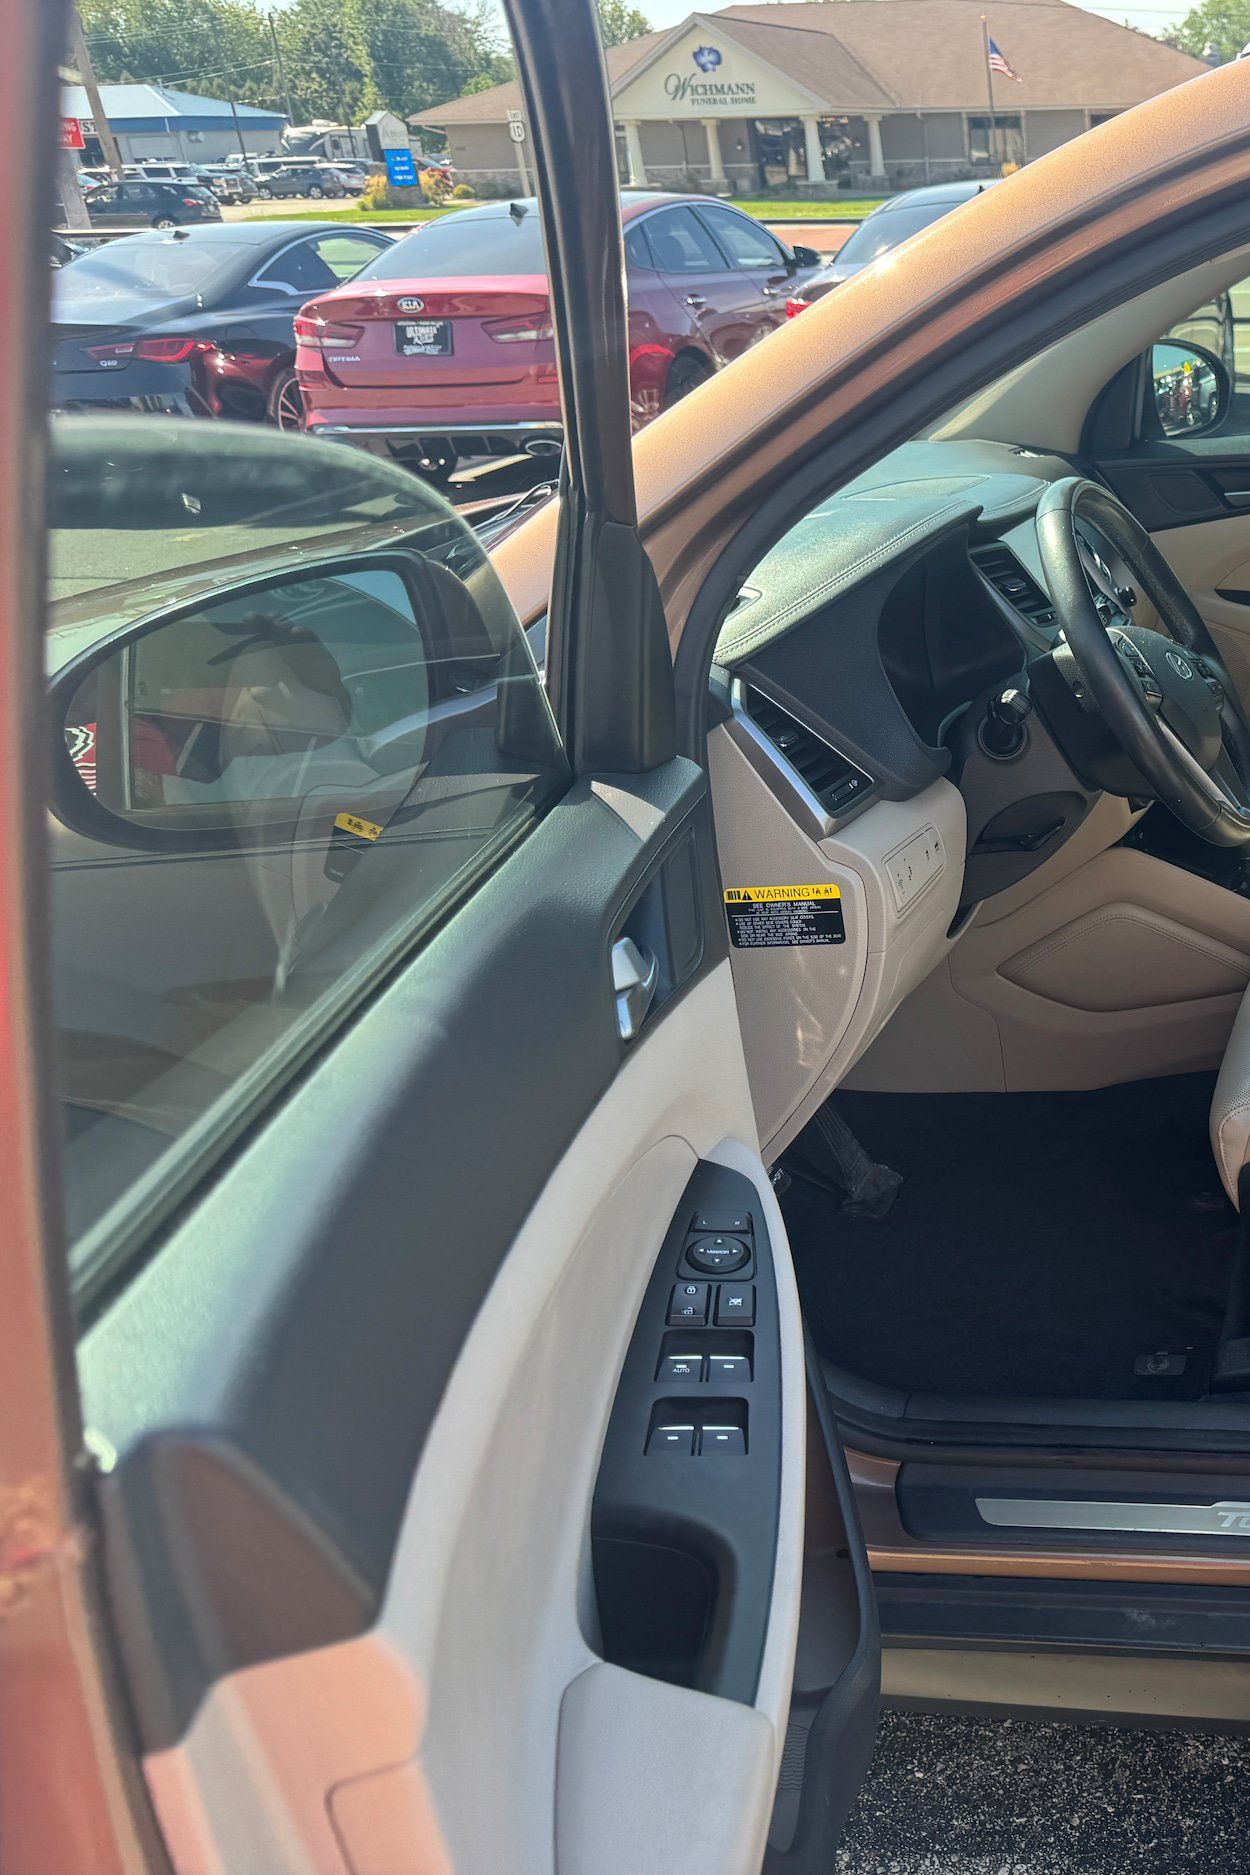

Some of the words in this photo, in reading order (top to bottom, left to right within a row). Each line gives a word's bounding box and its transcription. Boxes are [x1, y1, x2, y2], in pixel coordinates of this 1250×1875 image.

[664, 73, 756, 100] WICHMANN
[691, 97, 729, 105] FUNERAL
[730, 96, 756, 105] HOME
[400, 300, 420, 310] KIA
[754, 887, 810, 899] WARNING
